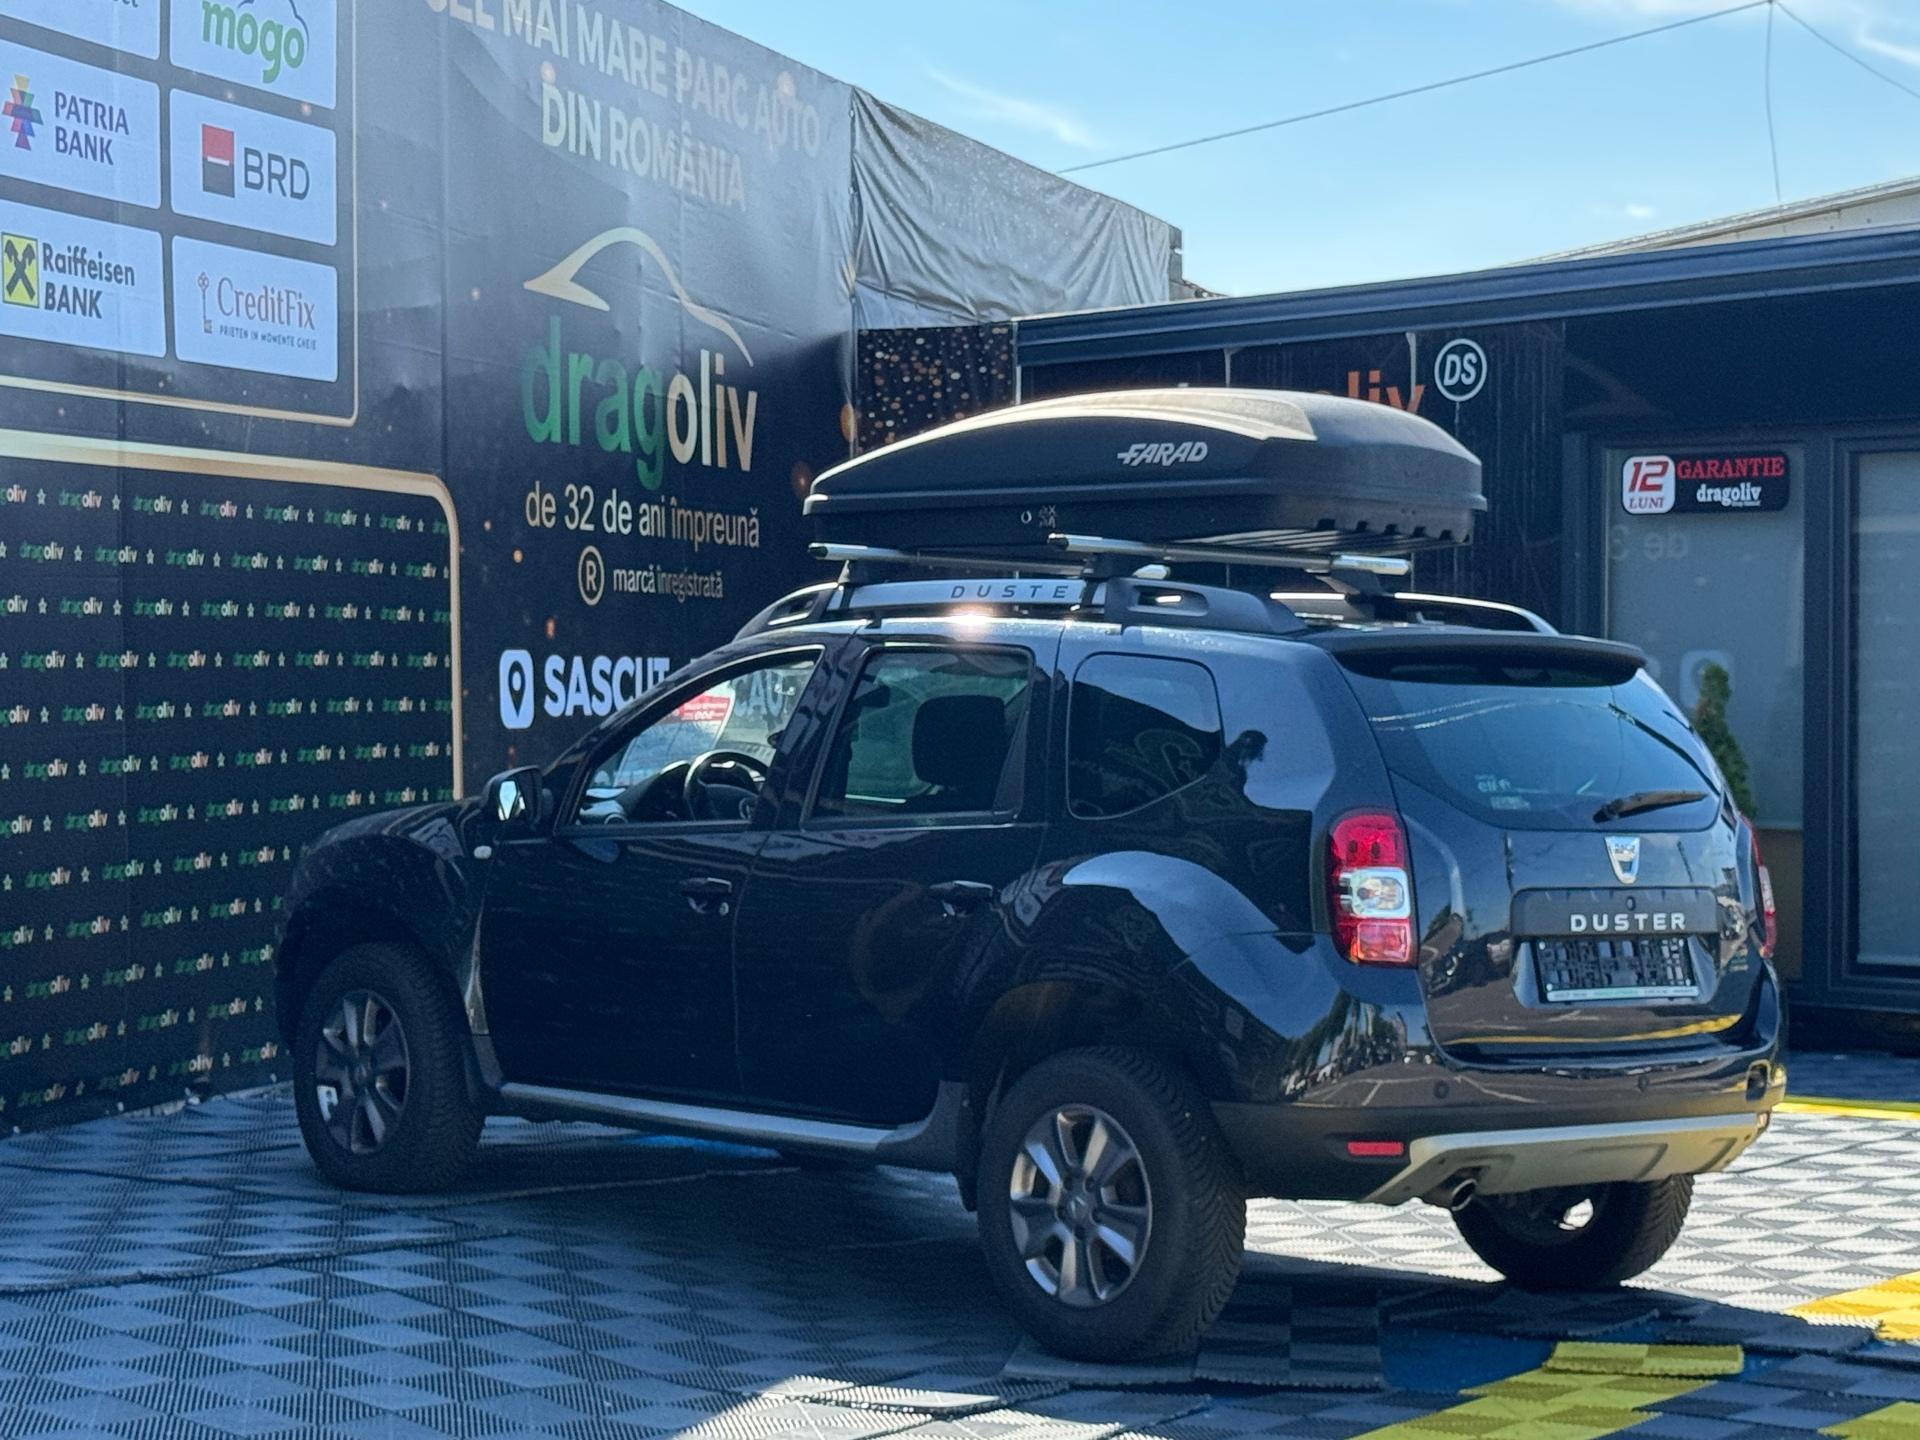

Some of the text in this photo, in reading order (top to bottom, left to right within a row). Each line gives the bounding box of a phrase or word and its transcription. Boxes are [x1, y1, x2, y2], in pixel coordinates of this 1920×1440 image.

[202, 2, 305, 83] mogo
[503, 0, 569, 58] MAI
[576, 4, 668, 98] MARE
[675, 47, 749, 131] PARC
[755, 84, 821, 158] AUTO
[54, 90, 130, 136] PATRIA
[54, 125, 114, 166] BANK
[541, 82, 746, 212] DIN ROMÂNIA
[243, 147, 311, 200] BRD
[42, 241, 135, 287] Raiffeisen
[44, 281, 103, 320] BANK
[217, 276, 315, 331] CreditFix
[1442, 352, 1478, 387] DS
[521, 315, 758, 490] dragoliv
[1117, 441, 1208, 467] FARAD
[1677, 457, 1785, 480] GARANTIE
[1628, 461, 1669, 493] 12
[1696, 482, 1761, 507] dragoliv
[526, 481, 760, 552] de 32 de ani împreună
[1628, 497, 1664, 510] LUNI
[613, 563, 656, 593] marcă
[950, 585, 1084, 599] DUSTE
[543, 654, 671, 717] SASCUT
[1570, 913, 1687, 932] DUSTER
